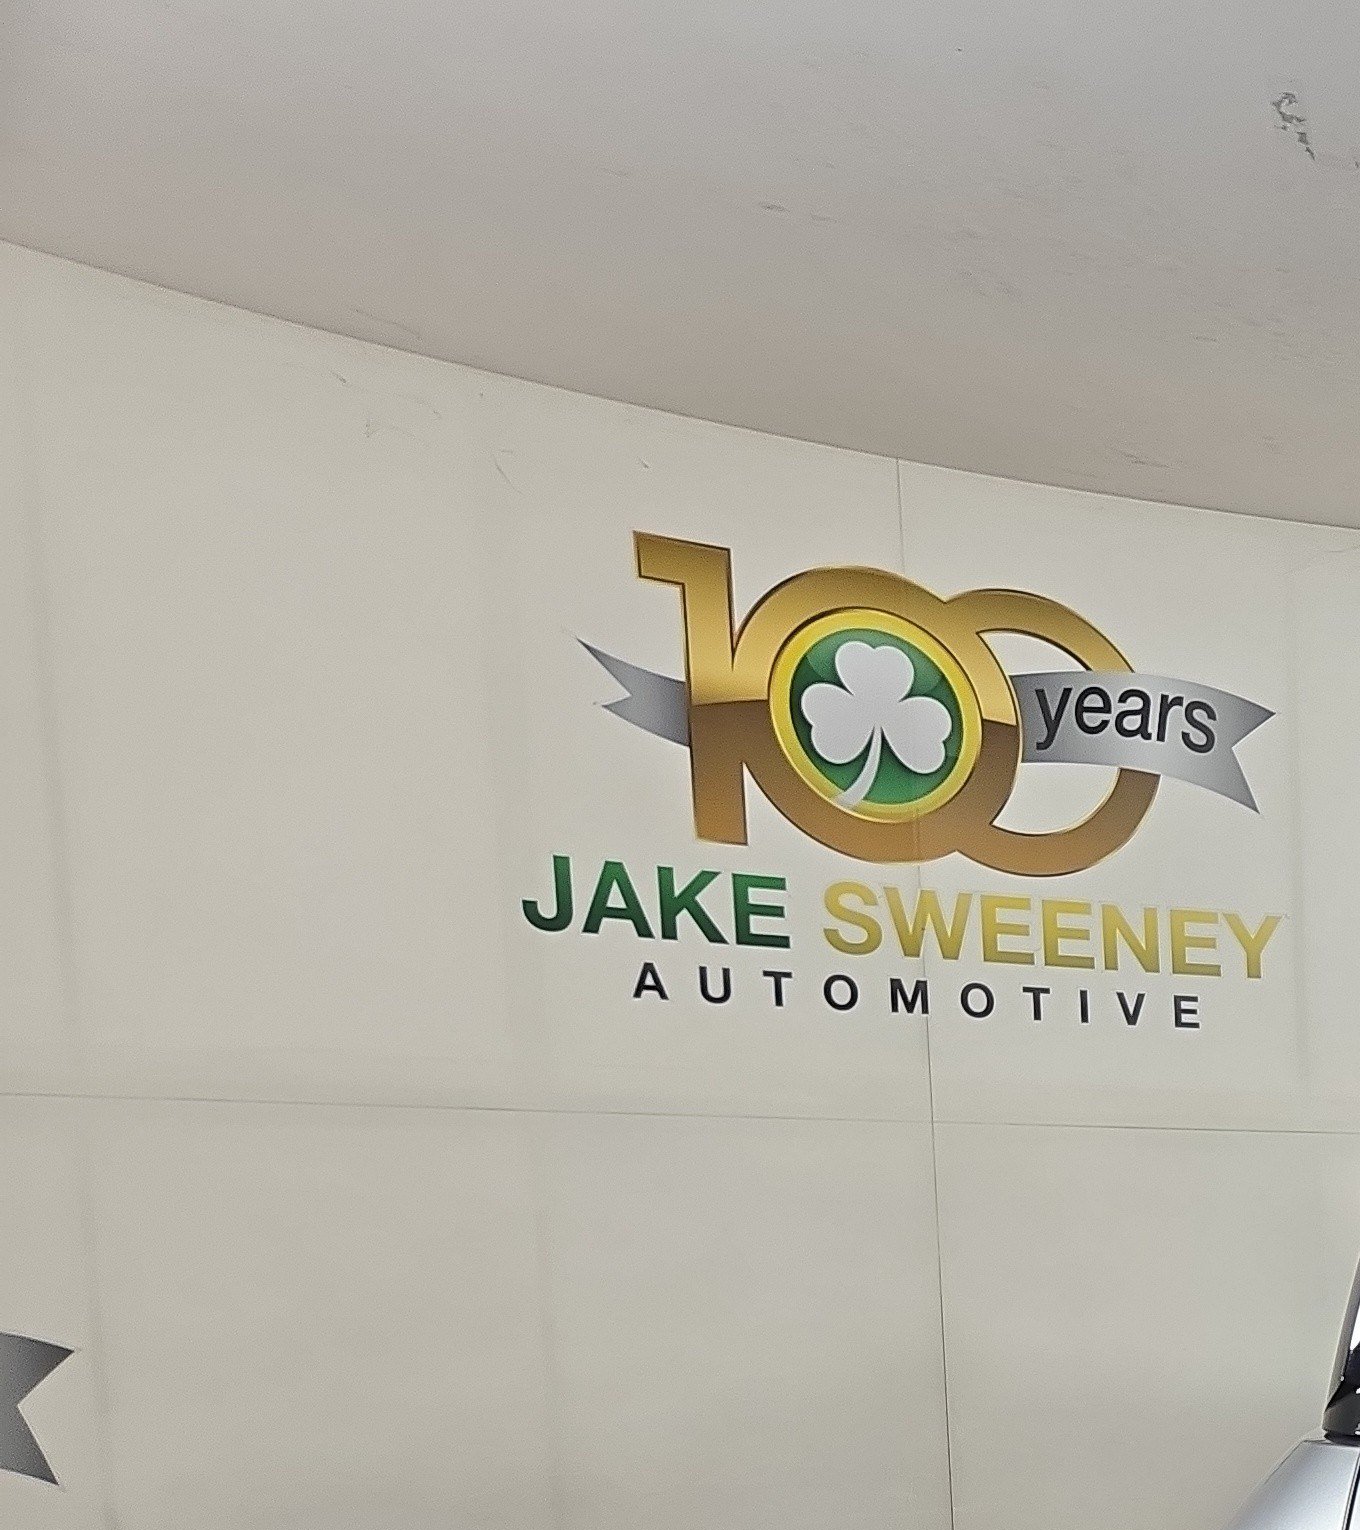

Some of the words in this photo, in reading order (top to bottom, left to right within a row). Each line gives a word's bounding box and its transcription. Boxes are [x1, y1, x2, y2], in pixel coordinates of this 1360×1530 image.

[633, 530, 1161, 877] 100
[1034, 681, 1218, 753] years
[522, 854, 791, 949] JAKE
[822, 881, 1283, 979] SWEENEY
[632, 962, 1201, 1028] AUTOMOTIVE
